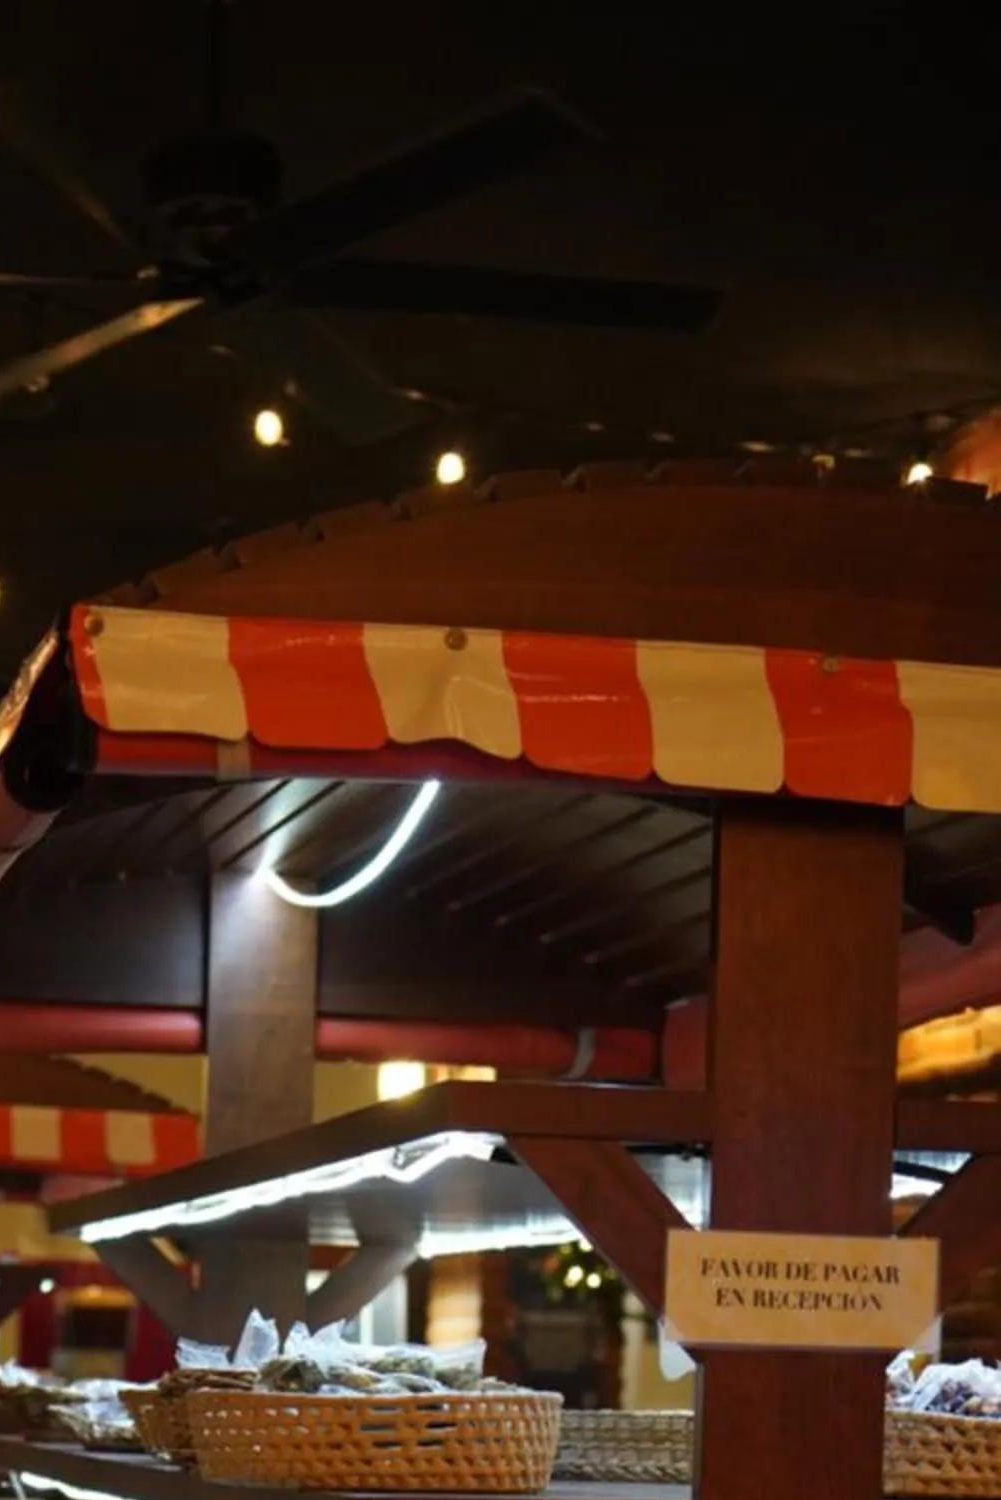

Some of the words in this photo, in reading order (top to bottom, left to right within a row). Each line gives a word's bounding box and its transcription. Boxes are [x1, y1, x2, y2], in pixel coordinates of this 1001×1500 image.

[700, 1258, 778, 1280] FAVOR
[785, 1262, 819, 1281] DE
[823, 1263, 900, 1284] PAGAR
[715, 1288, 746, 1307] EN
